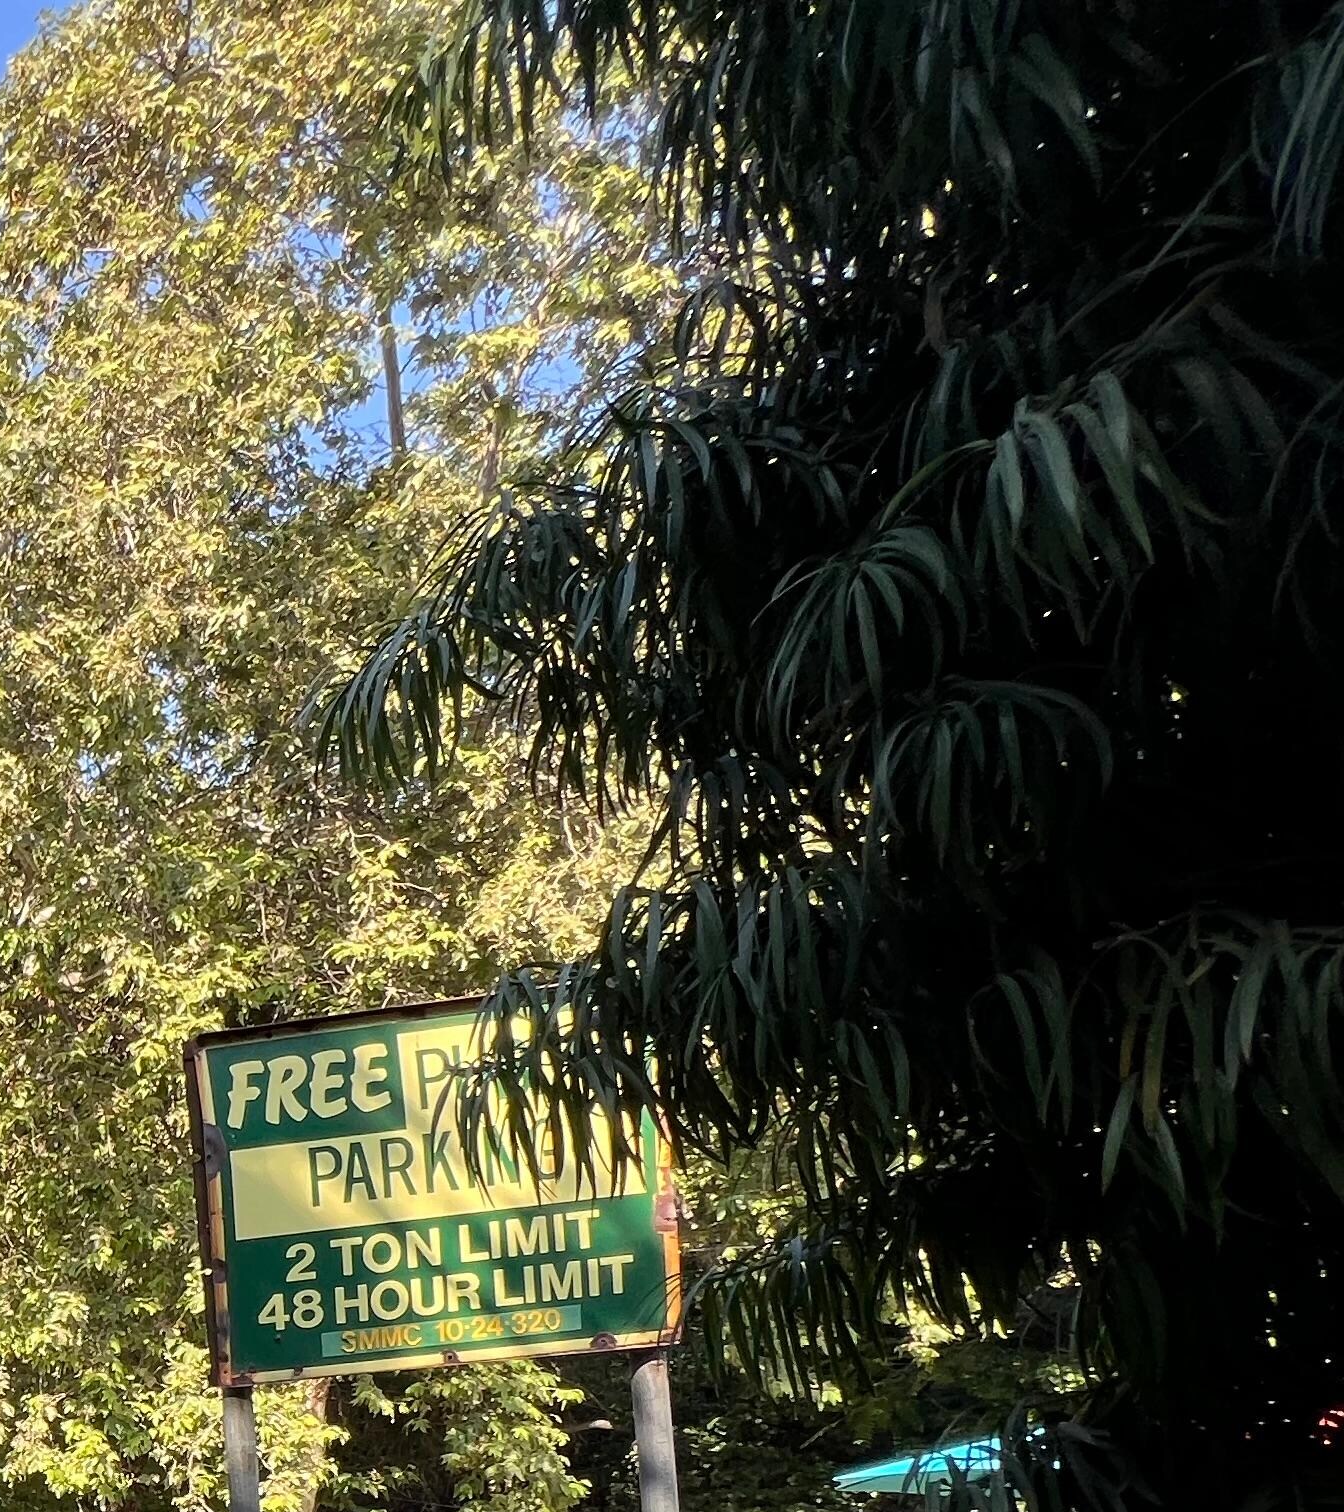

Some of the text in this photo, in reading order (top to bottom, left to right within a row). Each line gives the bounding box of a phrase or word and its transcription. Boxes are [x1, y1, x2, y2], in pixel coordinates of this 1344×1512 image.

[226, 1041, 393, 1131] FREE
[284, 1209, 600, 1284] 2 TON LIMIT
[257, 1255, 634, 1332] 48 HOUR LIMIT
[341, 1325, 422, 1354] SMMC
